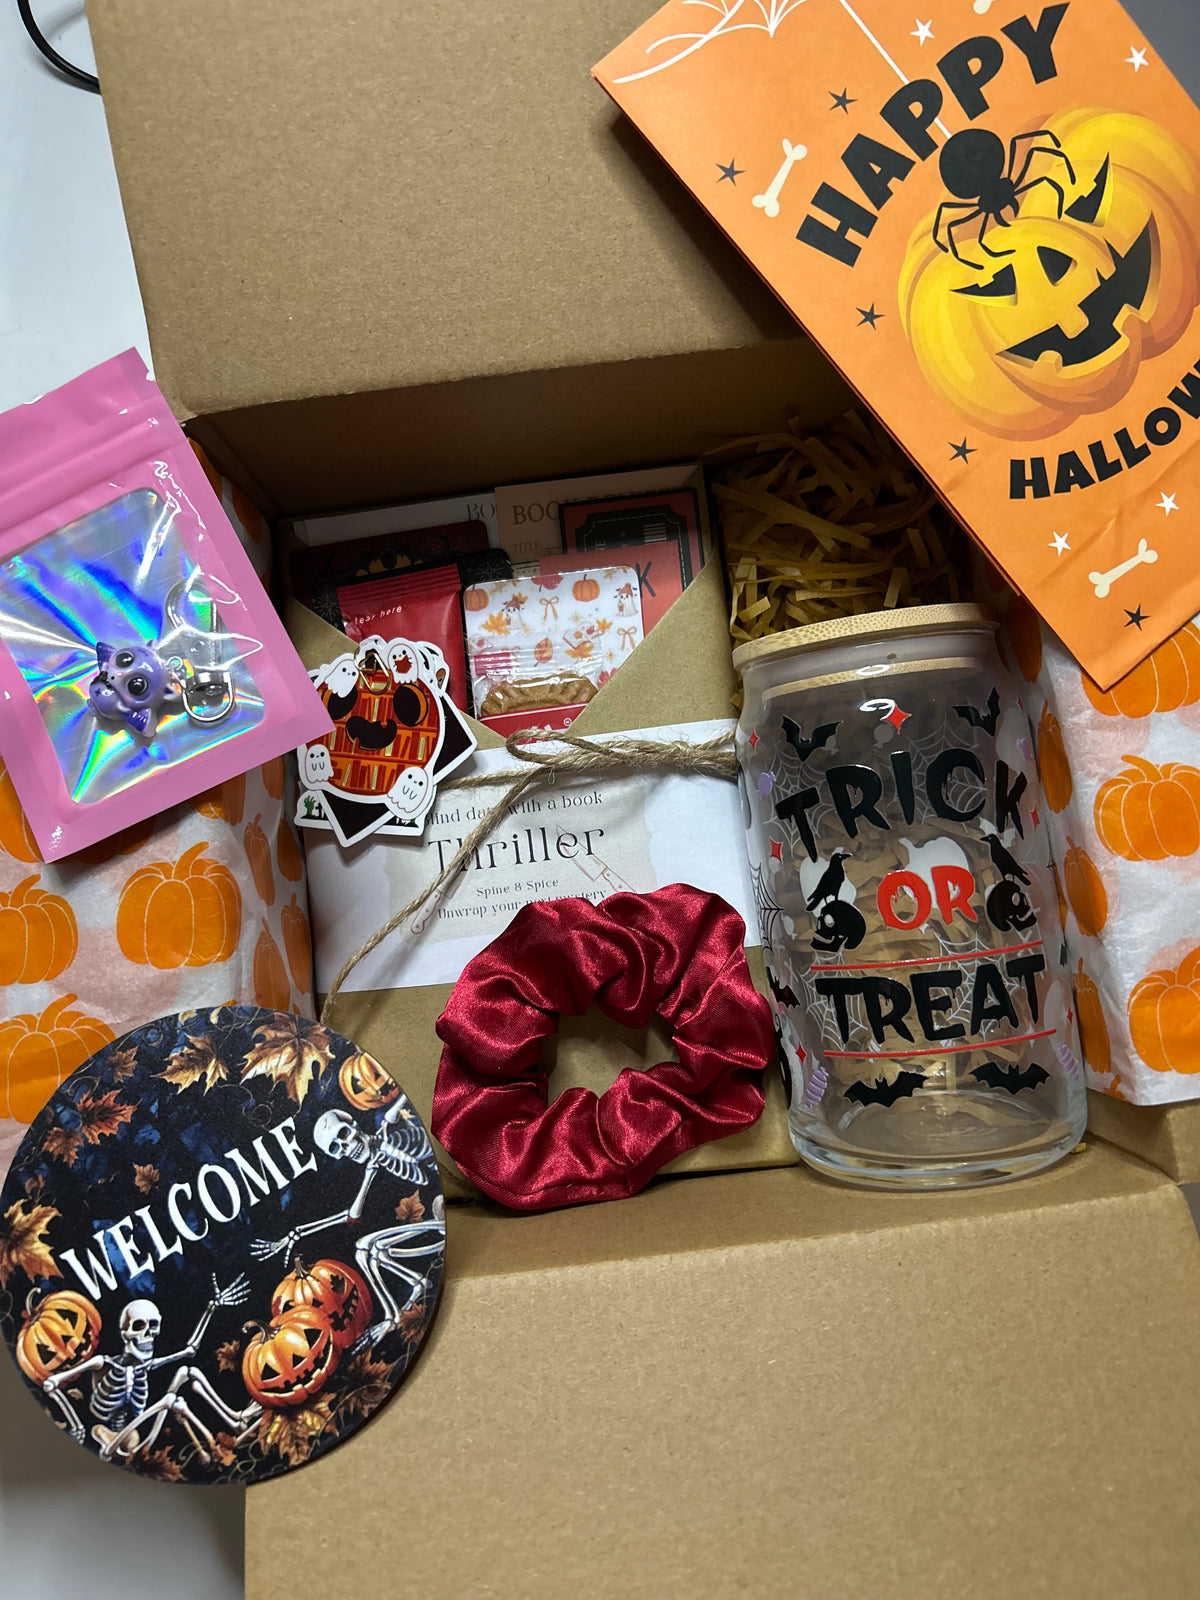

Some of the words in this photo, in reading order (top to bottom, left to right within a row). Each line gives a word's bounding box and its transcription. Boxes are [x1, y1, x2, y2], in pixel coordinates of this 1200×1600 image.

[796, 2, 1070, 268] HAPPY
[466, 503, 496, 521] BO
[512, 501, 560, 526] BOO
[354, 614, 376, 625] tear
[380, 605, 402, 618] here
[547, 799, 558, 811] a
[562, 790, 603, 809] book
[775, 748, 1028, 862] TRICK
[428, 826, 605, 874] Thriller
[475, 885, 510, 900] Spine
[526, 879, 560, 893] Spice
[877, 864, 976, 930] OR
[437, 903, 488, 920] Unwrap
[492, 900, 523, 917] your
[815, 953, 1046, 1046] TREAT
[60, 1115, 319, 1301] WELCOME
